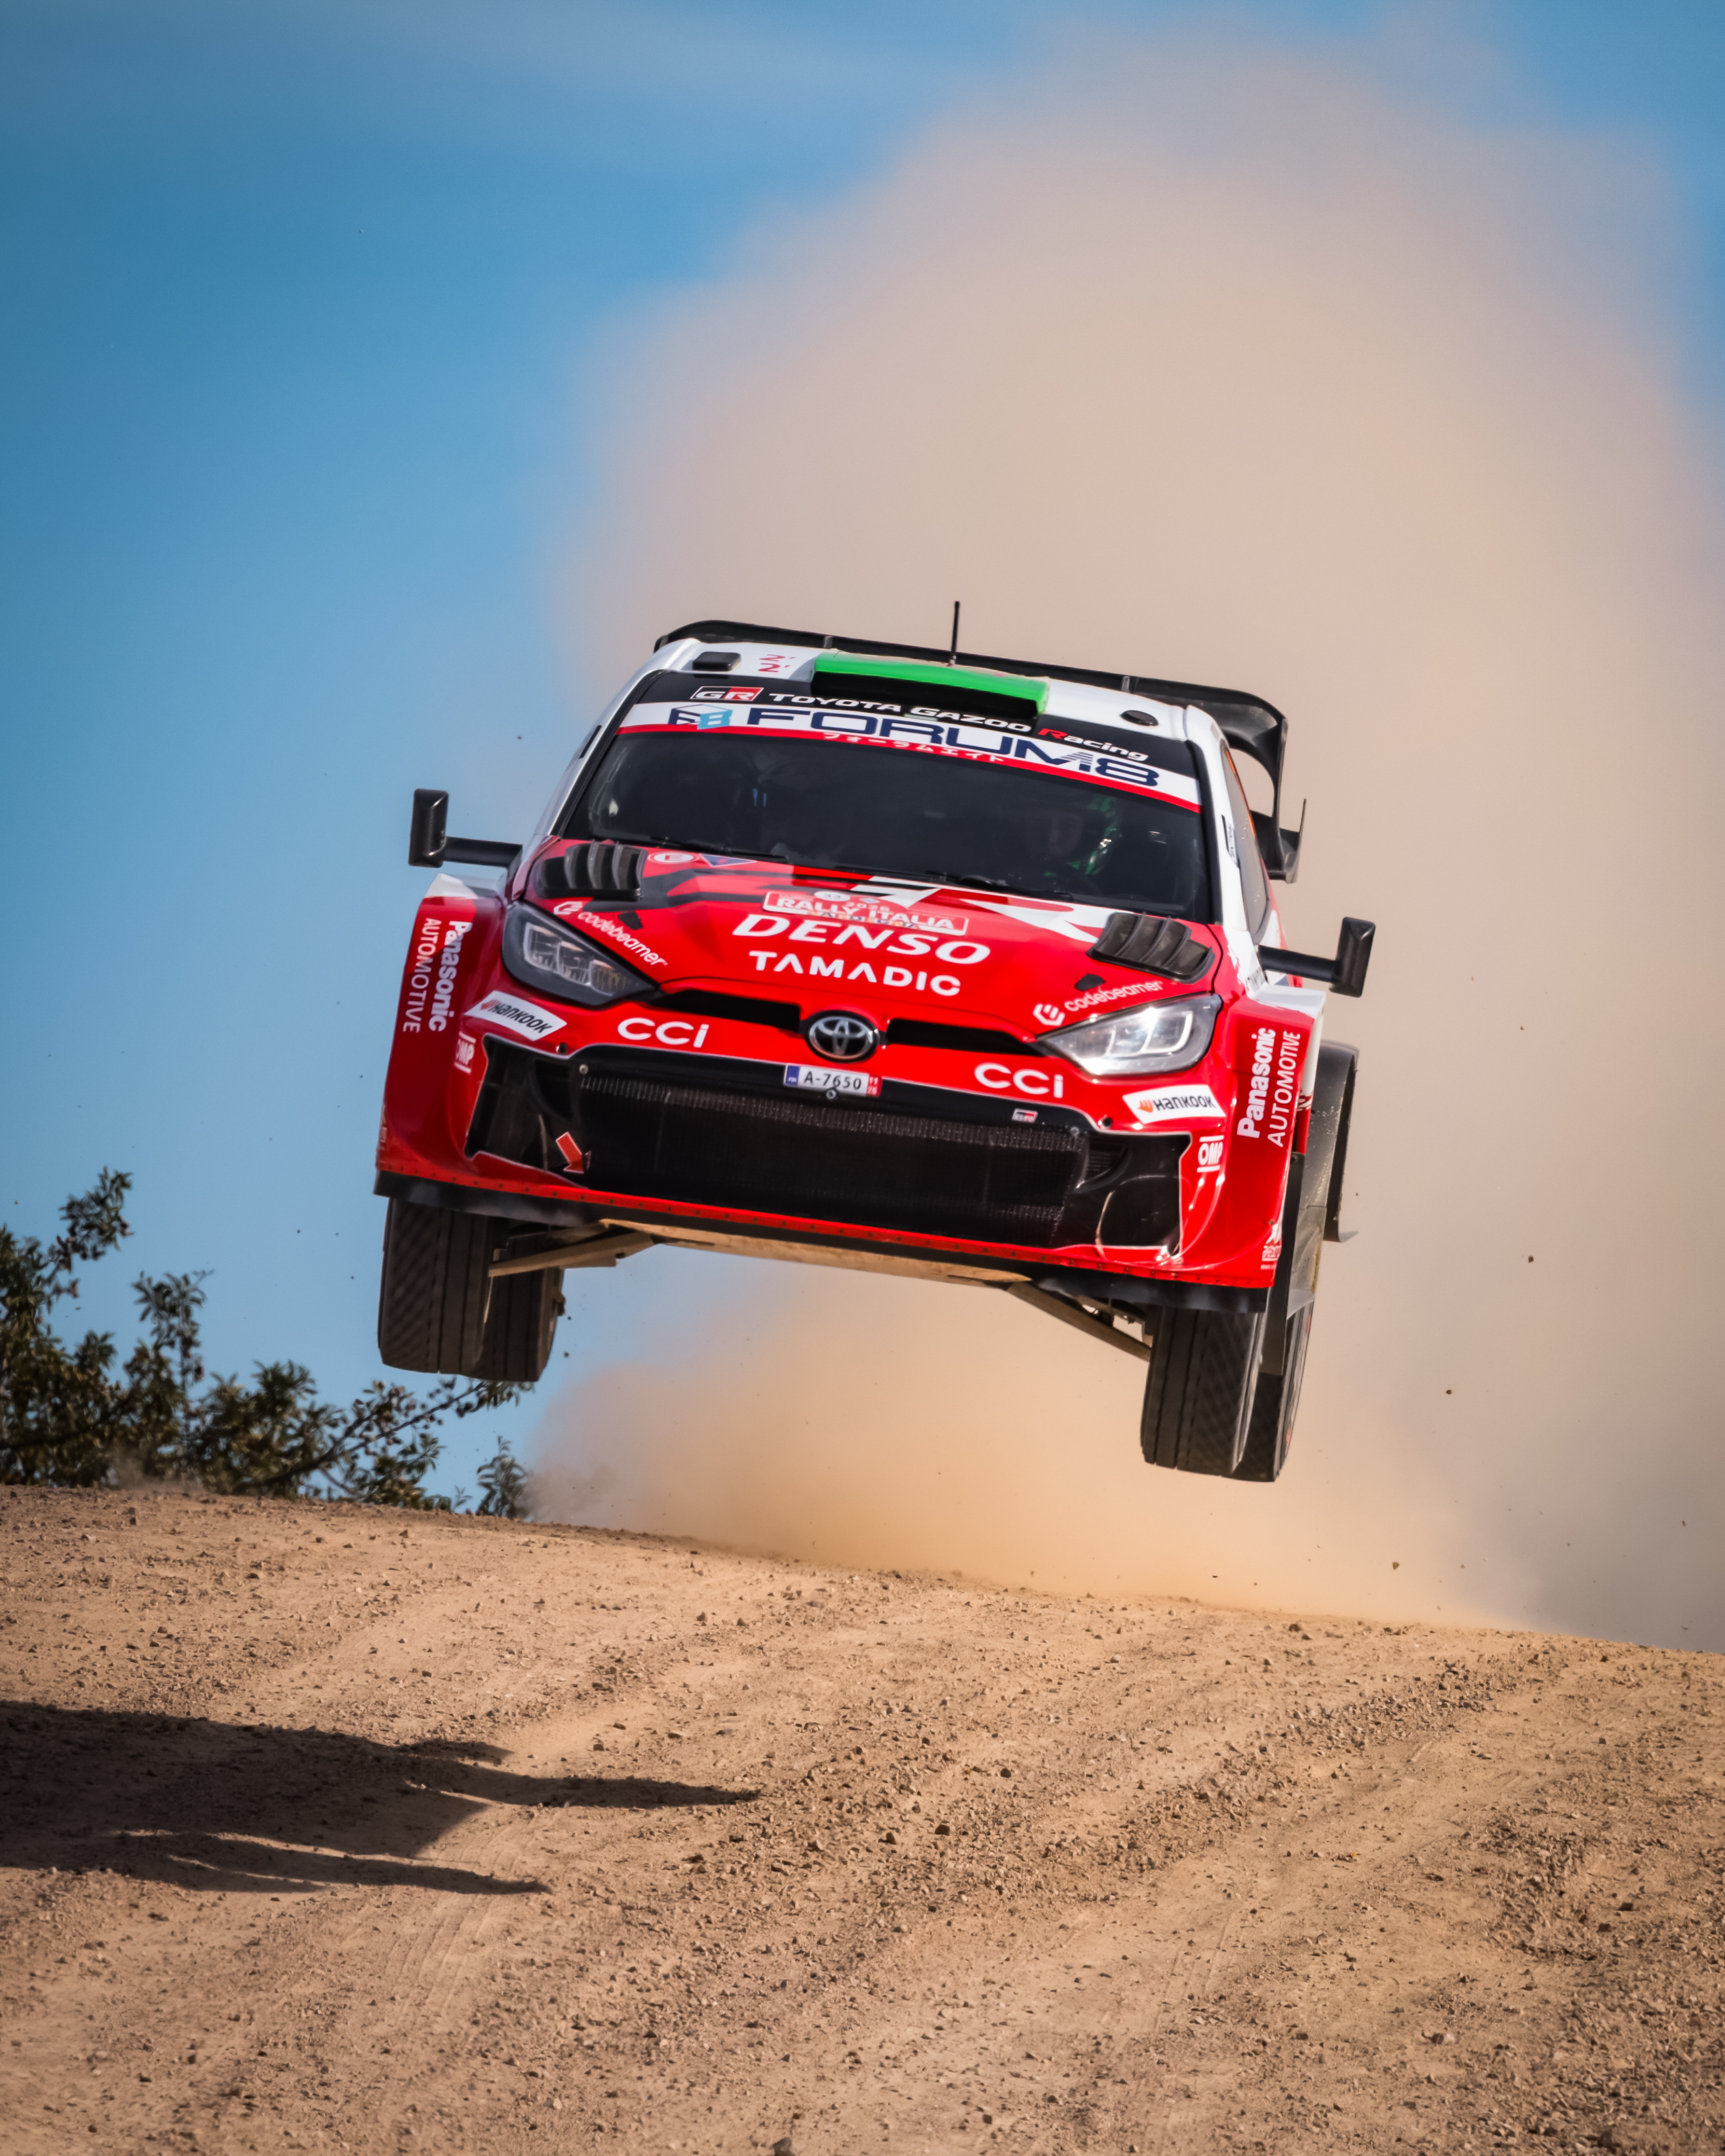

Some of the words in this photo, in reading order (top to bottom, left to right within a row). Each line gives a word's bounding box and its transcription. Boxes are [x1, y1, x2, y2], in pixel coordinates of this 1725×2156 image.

[696, 691, 755, 700] GR
[769, 693, 901, 712] TOYOTA
[909, 707, 1031, 732] GAZOO
[1038, 728, 1148, 762] Racing
[747, 707, 1160, 787] FORUM8
[577, 911, 665, 966] codebeamer
[732, 914, 991, 964] DENSO
[777, 899, 861, 915] RALLY
[869, 909, 954, 929] ITALIA
[403, 917, 443, 1034] AUTOMOTIVE
[429, 921, 473, 1032] Panasonic
[749, 950, 961, 997] TAMADIC
[1064, 980, 1163, 1012] codebeamer
[804, 1070, 862, 1090] A-7650
[1237, 1027, 1276, 1139] Panasonic
[1267, 1029, 1301, 1148] AUTOMOTIVE
[1197, 1142, 1224, 1166] OMP
